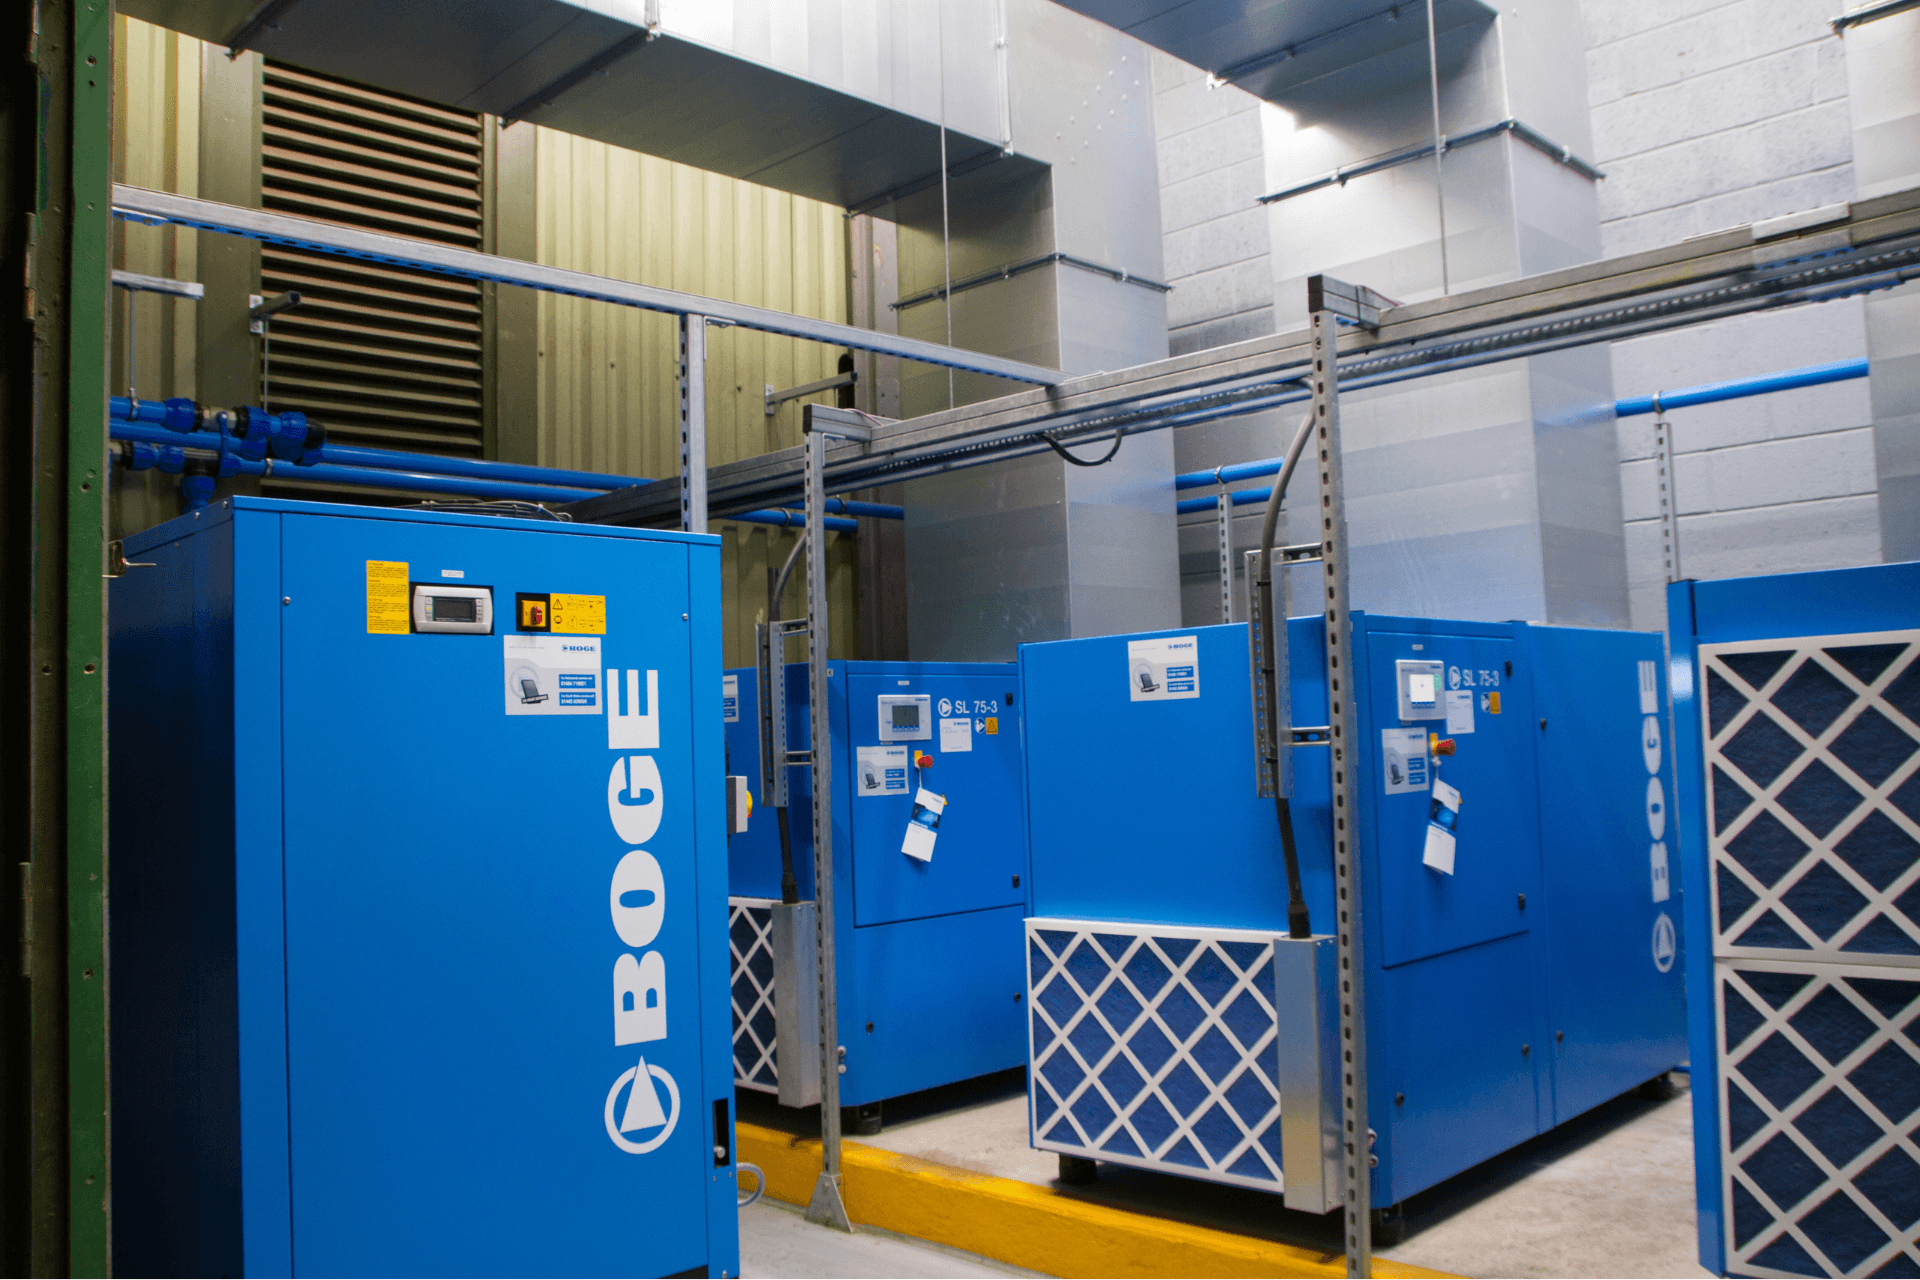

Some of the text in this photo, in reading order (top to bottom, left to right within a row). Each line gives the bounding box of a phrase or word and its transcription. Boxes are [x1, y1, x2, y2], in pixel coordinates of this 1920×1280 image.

[955, 700, 998, 714] SL 75-3
[1462, 669, 1500, 687] SL 75-3
[1637, 661, 1671, 903] BOGE
[607, 669, 667, 1046] BOGE
